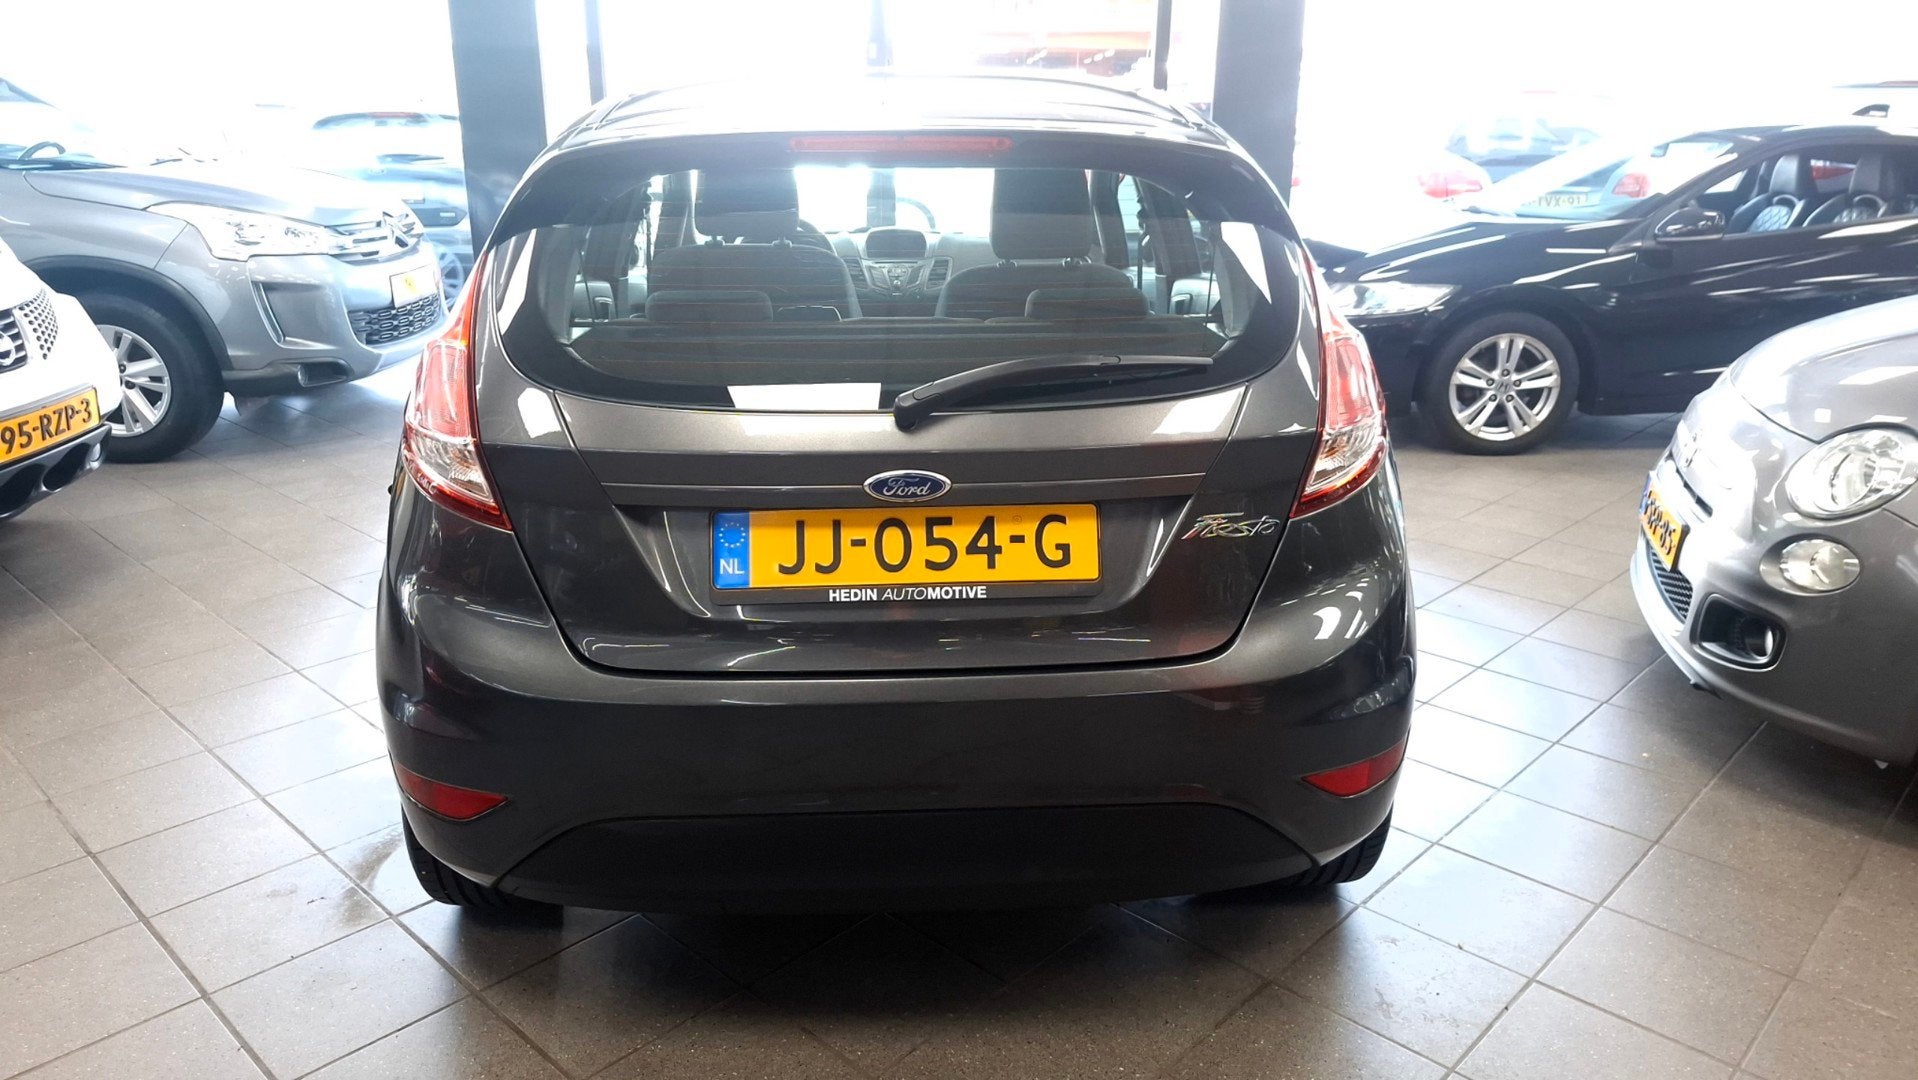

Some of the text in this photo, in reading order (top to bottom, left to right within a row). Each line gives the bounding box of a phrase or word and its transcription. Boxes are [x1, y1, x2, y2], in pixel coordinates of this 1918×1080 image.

[0, 398, 92, 455] 95-RZP-3
[882, 476, 932, 497] Ford
[1180, 511, 1280, 539] Fiesta
[778, 513, 1071, 575] JJ-054-G
[719, 558, 745, 575] NL
[828, 586, 988, 602] HEDIN AUTOMOTIVE
